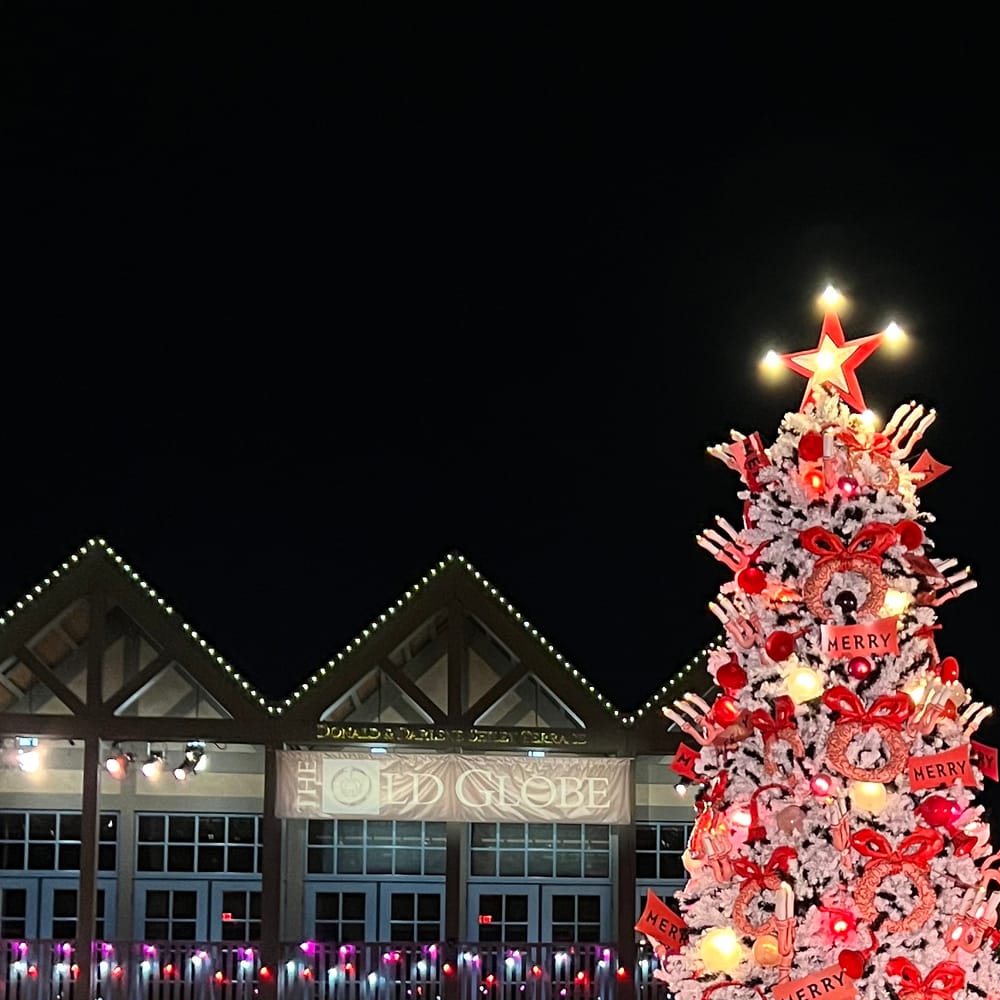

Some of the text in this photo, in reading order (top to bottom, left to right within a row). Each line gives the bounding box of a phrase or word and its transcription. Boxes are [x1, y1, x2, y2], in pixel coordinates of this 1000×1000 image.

[827, 633, 891, 651] MERRY
[913, 760, 966, 781] MERRY
[297, 759, 318, 812] THE
[455, 768, 611, 810] GLOBE
